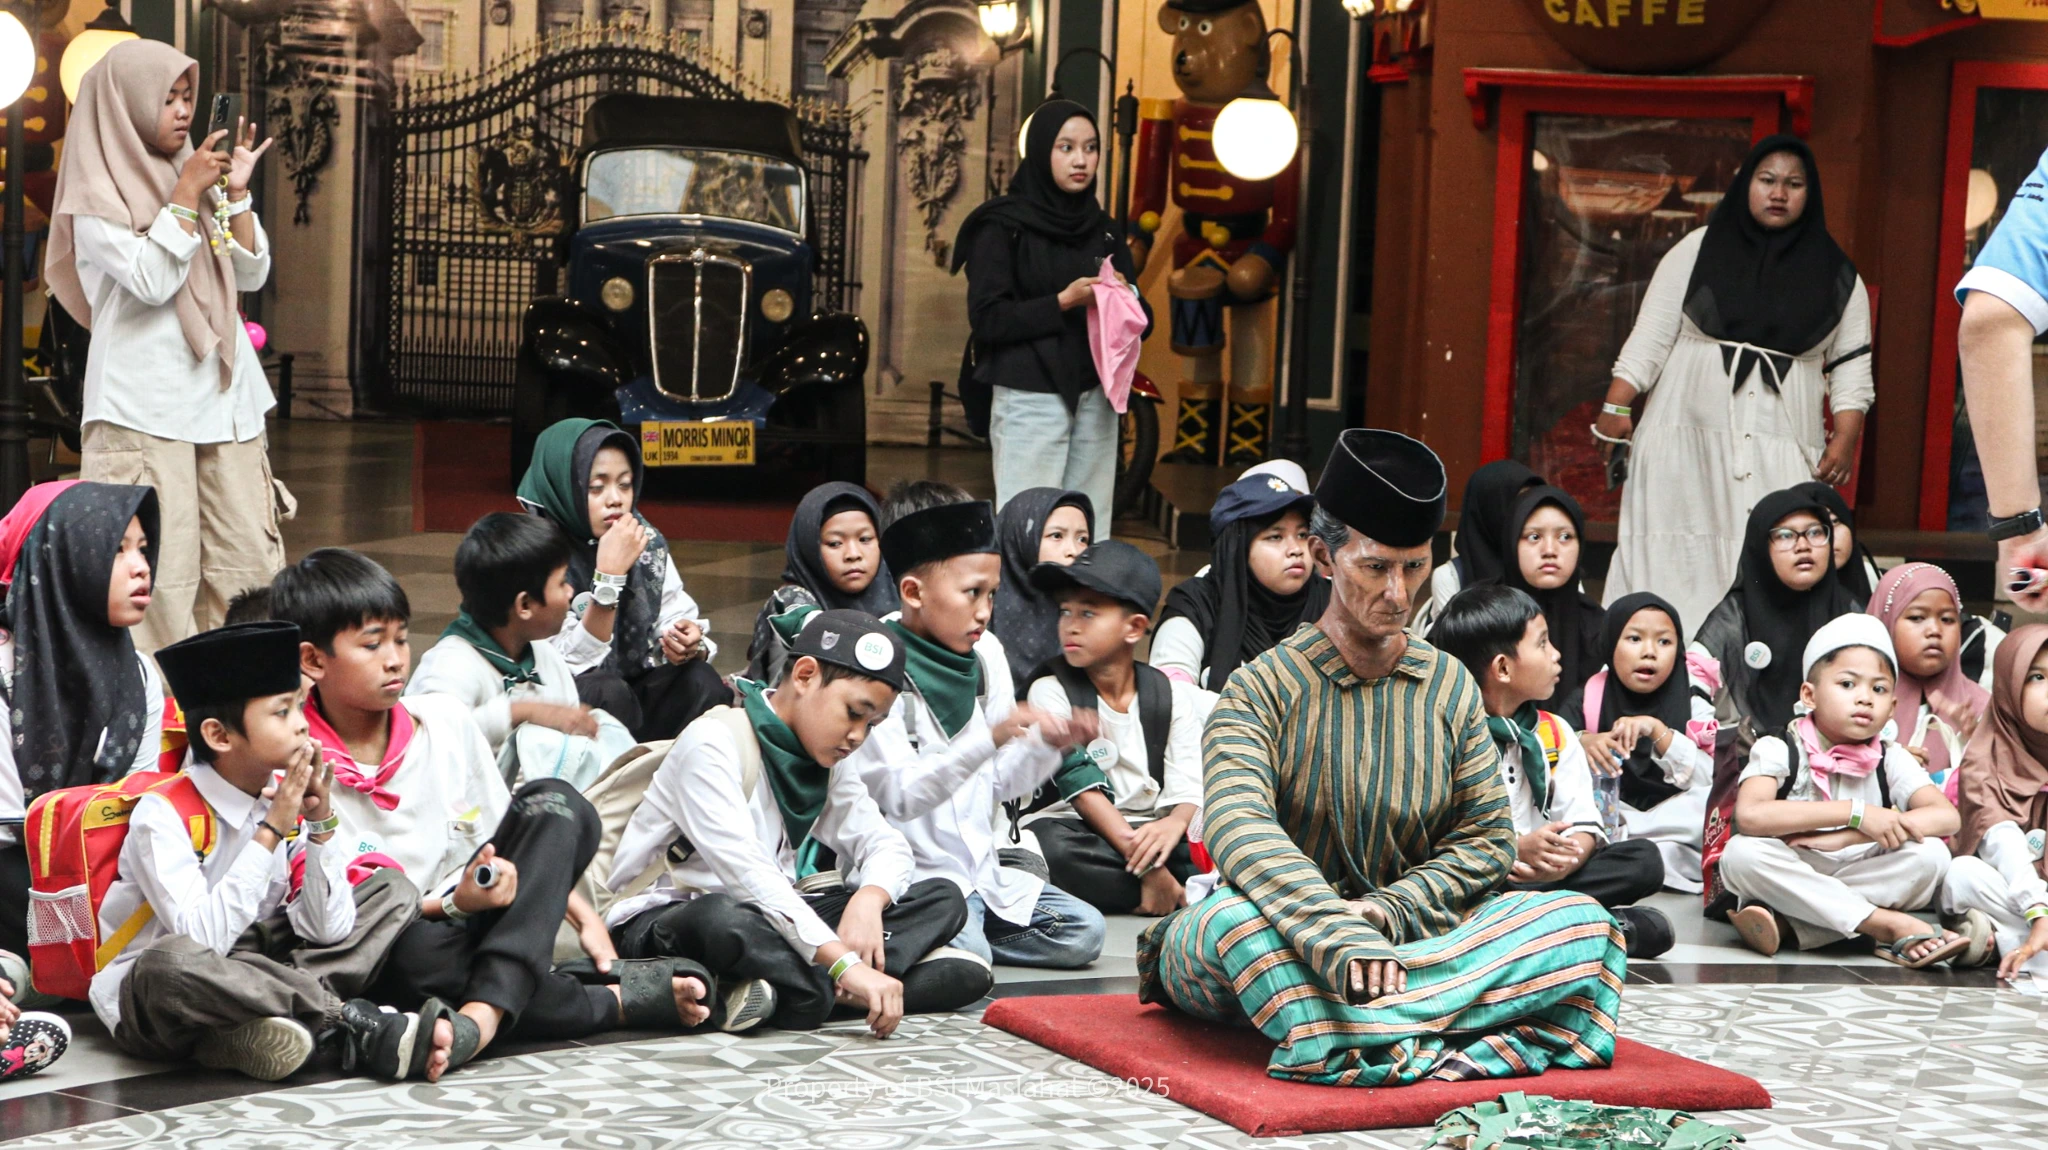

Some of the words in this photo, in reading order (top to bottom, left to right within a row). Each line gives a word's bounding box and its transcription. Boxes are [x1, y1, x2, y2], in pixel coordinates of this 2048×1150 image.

[1544, 0, 1705, 27] CAFFE
[663, 428, 709, 448] MORRIS
[711, 427, 751, 447] MINOR
[644, 451, 658, 461] UK
[663, 450, 679, 461] 1934
[864, 642, 884, 655] BSI
[1749, 649, 1761, 662] BSI
[1092, 747, 1108, 759] BSI
[2029, 836, 2044, 851] BSI
